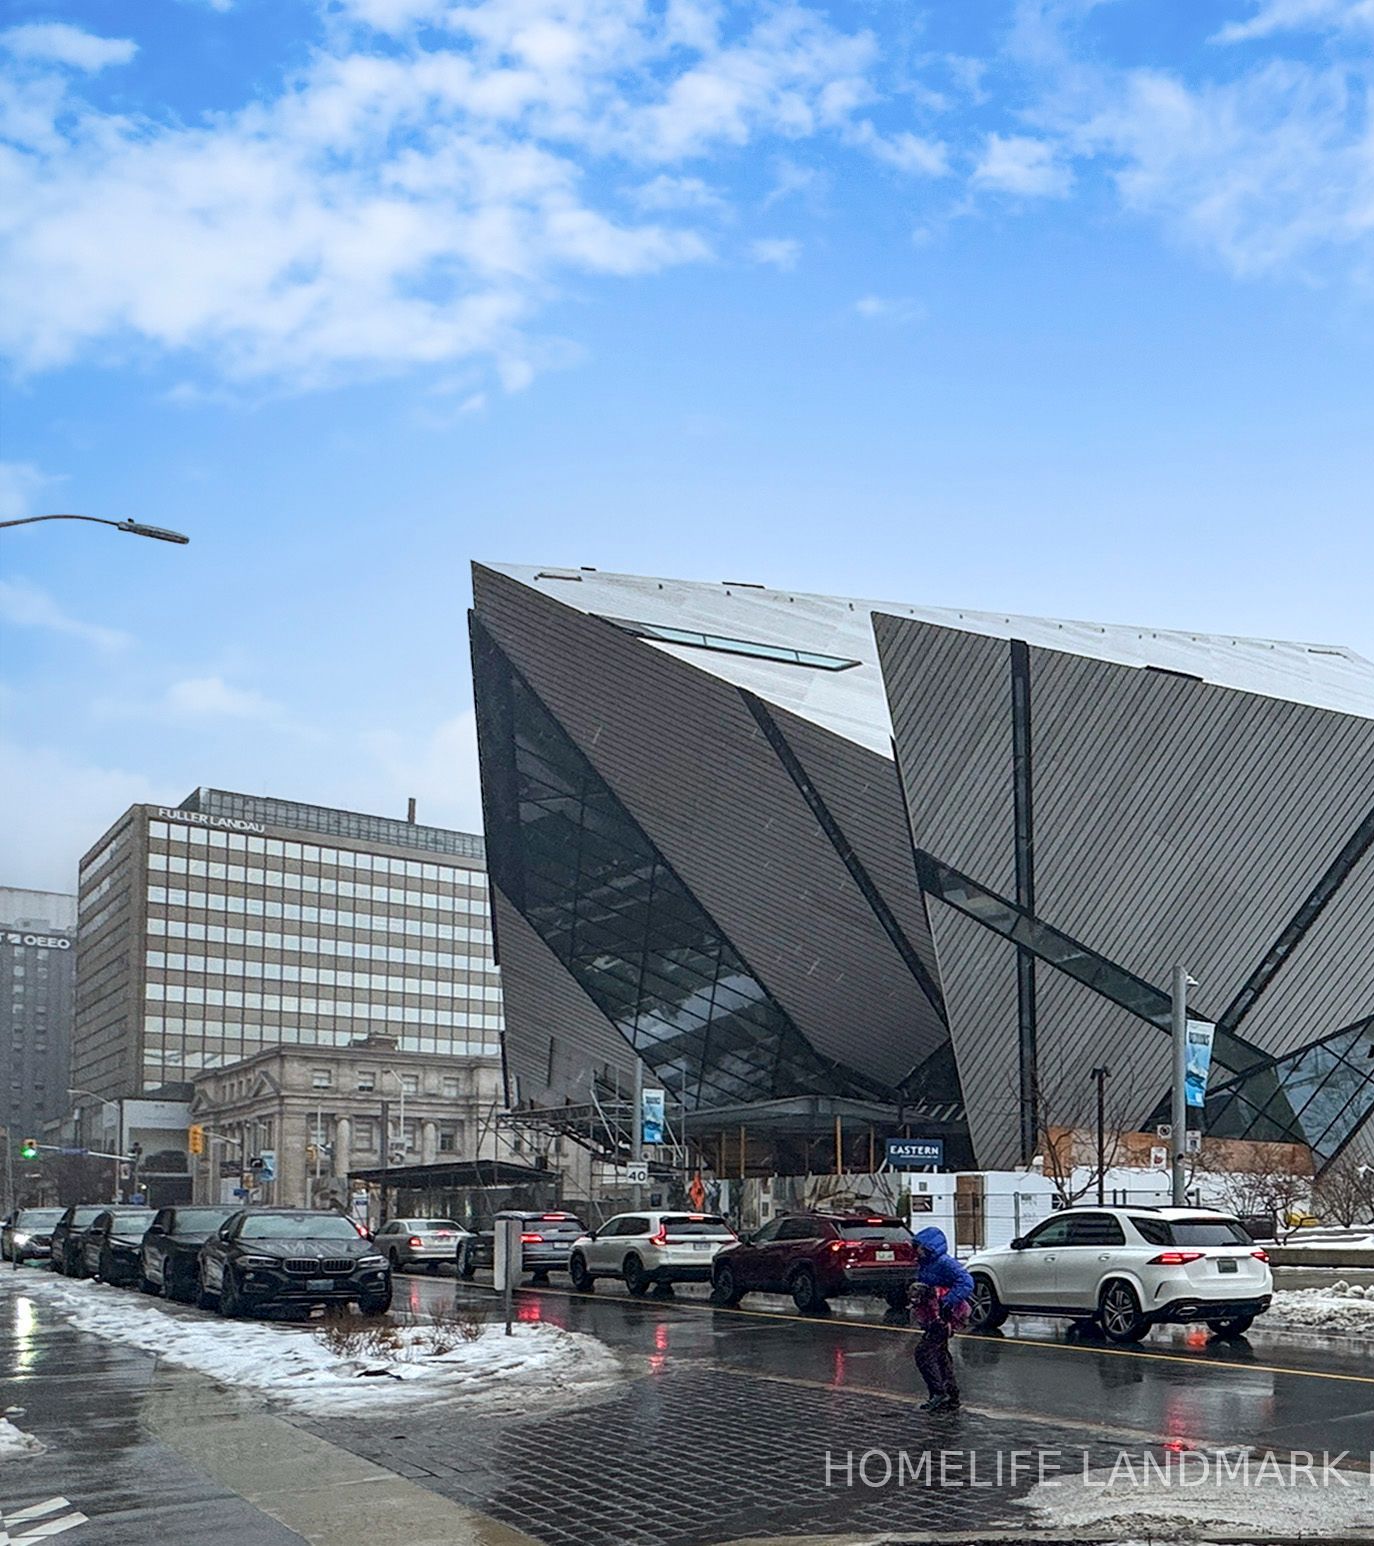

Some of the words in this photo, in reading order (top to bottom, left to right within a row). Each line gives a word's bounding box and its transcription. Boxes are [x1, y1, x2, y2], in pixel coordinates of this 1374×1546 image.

[159, 808, 208, 824] FULLER
[210, 817, 265, 833] LANDAU
[890, 1145, 939, 1155] EASTERN
[628, 1171, 647, 1182] 40
